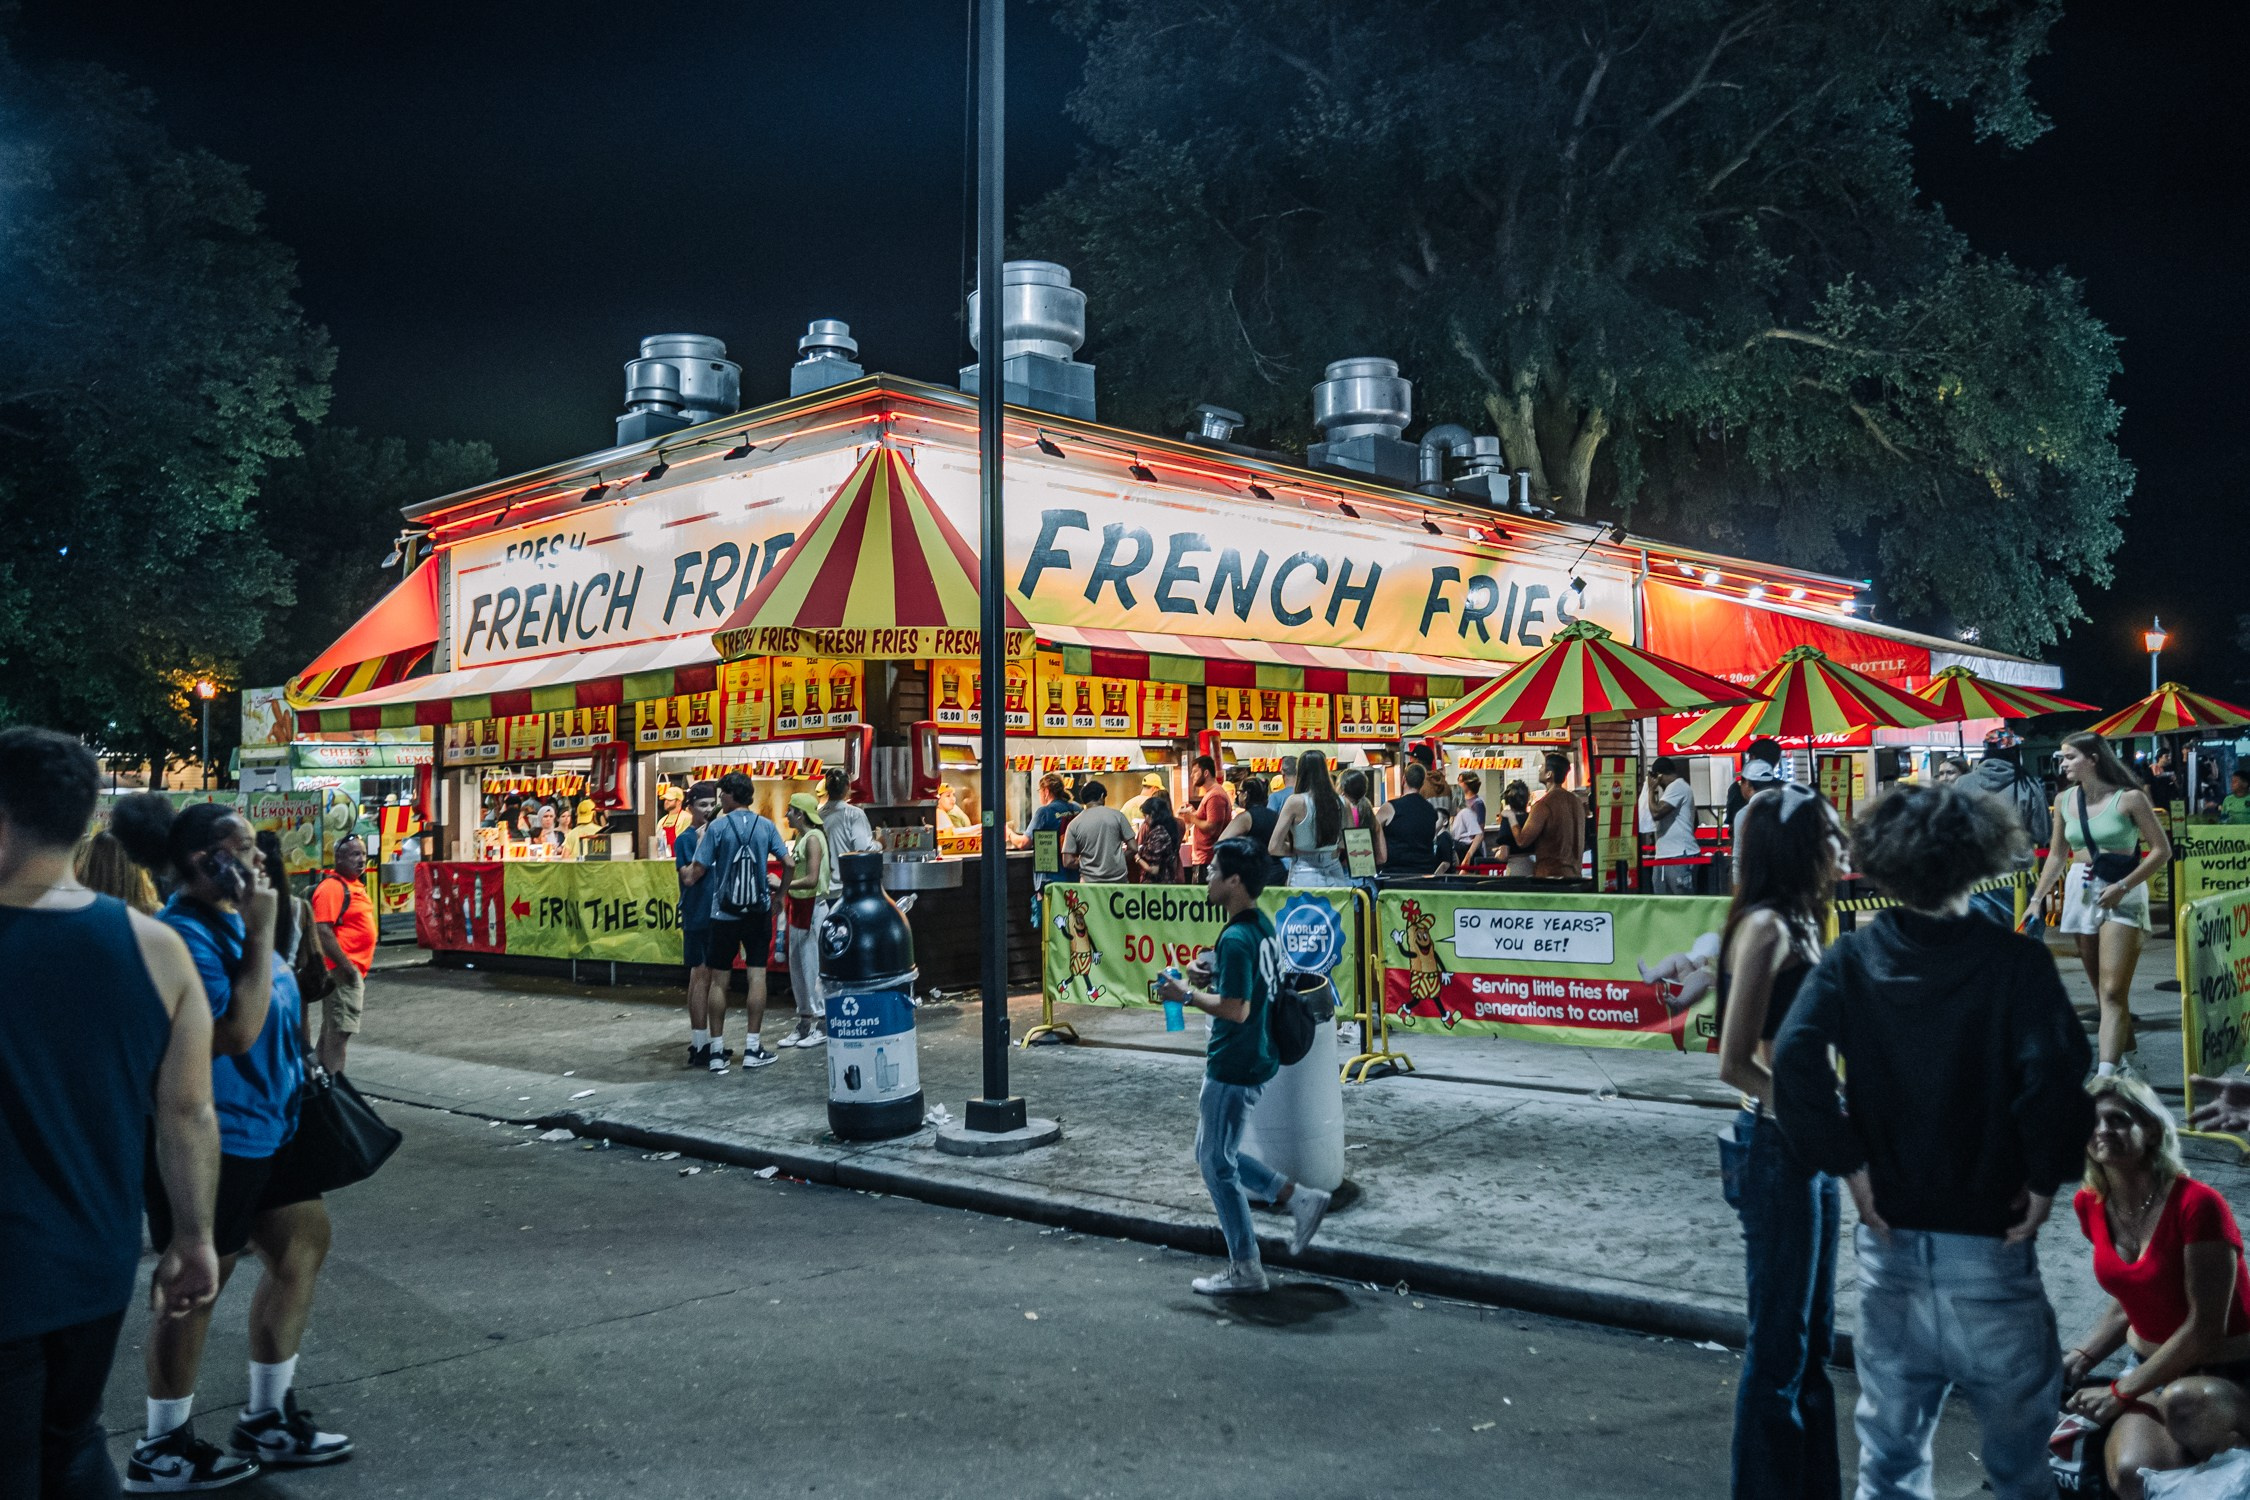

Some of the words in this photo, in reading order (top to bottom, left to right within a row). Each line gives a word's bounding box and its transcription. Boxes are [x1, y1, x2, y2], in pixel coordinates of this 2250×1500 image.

[1017, 508, 1383, 631] FRENCH
[1418, 565, 1586, 646] FRIES
[462, 564, 645, 657] FRENCH
[721, 628, 758, 658] FRESH
[758, 626, 801, 653] FRIES
[815, 628, 867, 654] FRESH
[871, 628, 919, 654] FRIES
[934, 629, 981, 655] FRESH
[1005, 630, 1023, 656] IES
[1850, 658, 1907, 673] BOTTLE
[1729, 672, 1756, 684] 20oz
[780, 718, 797, 729] $8.00
[804, 714, 822, 725] $9.50
[831, 713, 853, 724] $15.00
[940, 711, 961, 721] $8.00
[970, 713, 982, 722] $9.
[1004, 714, 1024, 724] 15.00
[1046, 716, 1065, 727] $8.00
[1075, 717, 1093, 727] $9.50
[1105, 718, 1125, 728] $15.00
[665, 729, 680, 739] $9.50
[690, 726, 709, 737] $15.00
[319, 747, 373, 758] CHEESE
[396, 755, 434, 765] LEMO
[336, 758, 368, 767] STICK
[253, 804, 319, 818] LEMONADE
[2185, 835, 2247, 855] Serving
[2200, 856, 2250, 871] world'
[583, 897, 640, 933] THE
[2233, 903, 2250, 939] YO
[1286, 924, 1328, 935] WORLD'S
[1458, 915, 1481, 929] 50
[1489, 916, 1534, 931] MORE
[1543, 917, 1607, 933] YEARS?
[1124, 934, 1155, 964] 50
[1286, 934, 1329, 953] BEST
[1494, 937, 1524, 951] YOU
[1533, 938, 1570, 953] BET!
[1471, 977, 1530, 999] Serving
[1532, 978, 1565, 998] little
[1568, 980, 1603, 999] fries
[1606, 982, 1630, 1001] for
[1474, 1000, 1565, 1023] generations
[1567, 1004, 1585, 1021] to
[1588, 1006, 1639, 1024] come!
[830, 1016, 852, 1029] glass
[854, 1016, 880, 1027] cans
[837, 1026, 868, 1038] plastic
